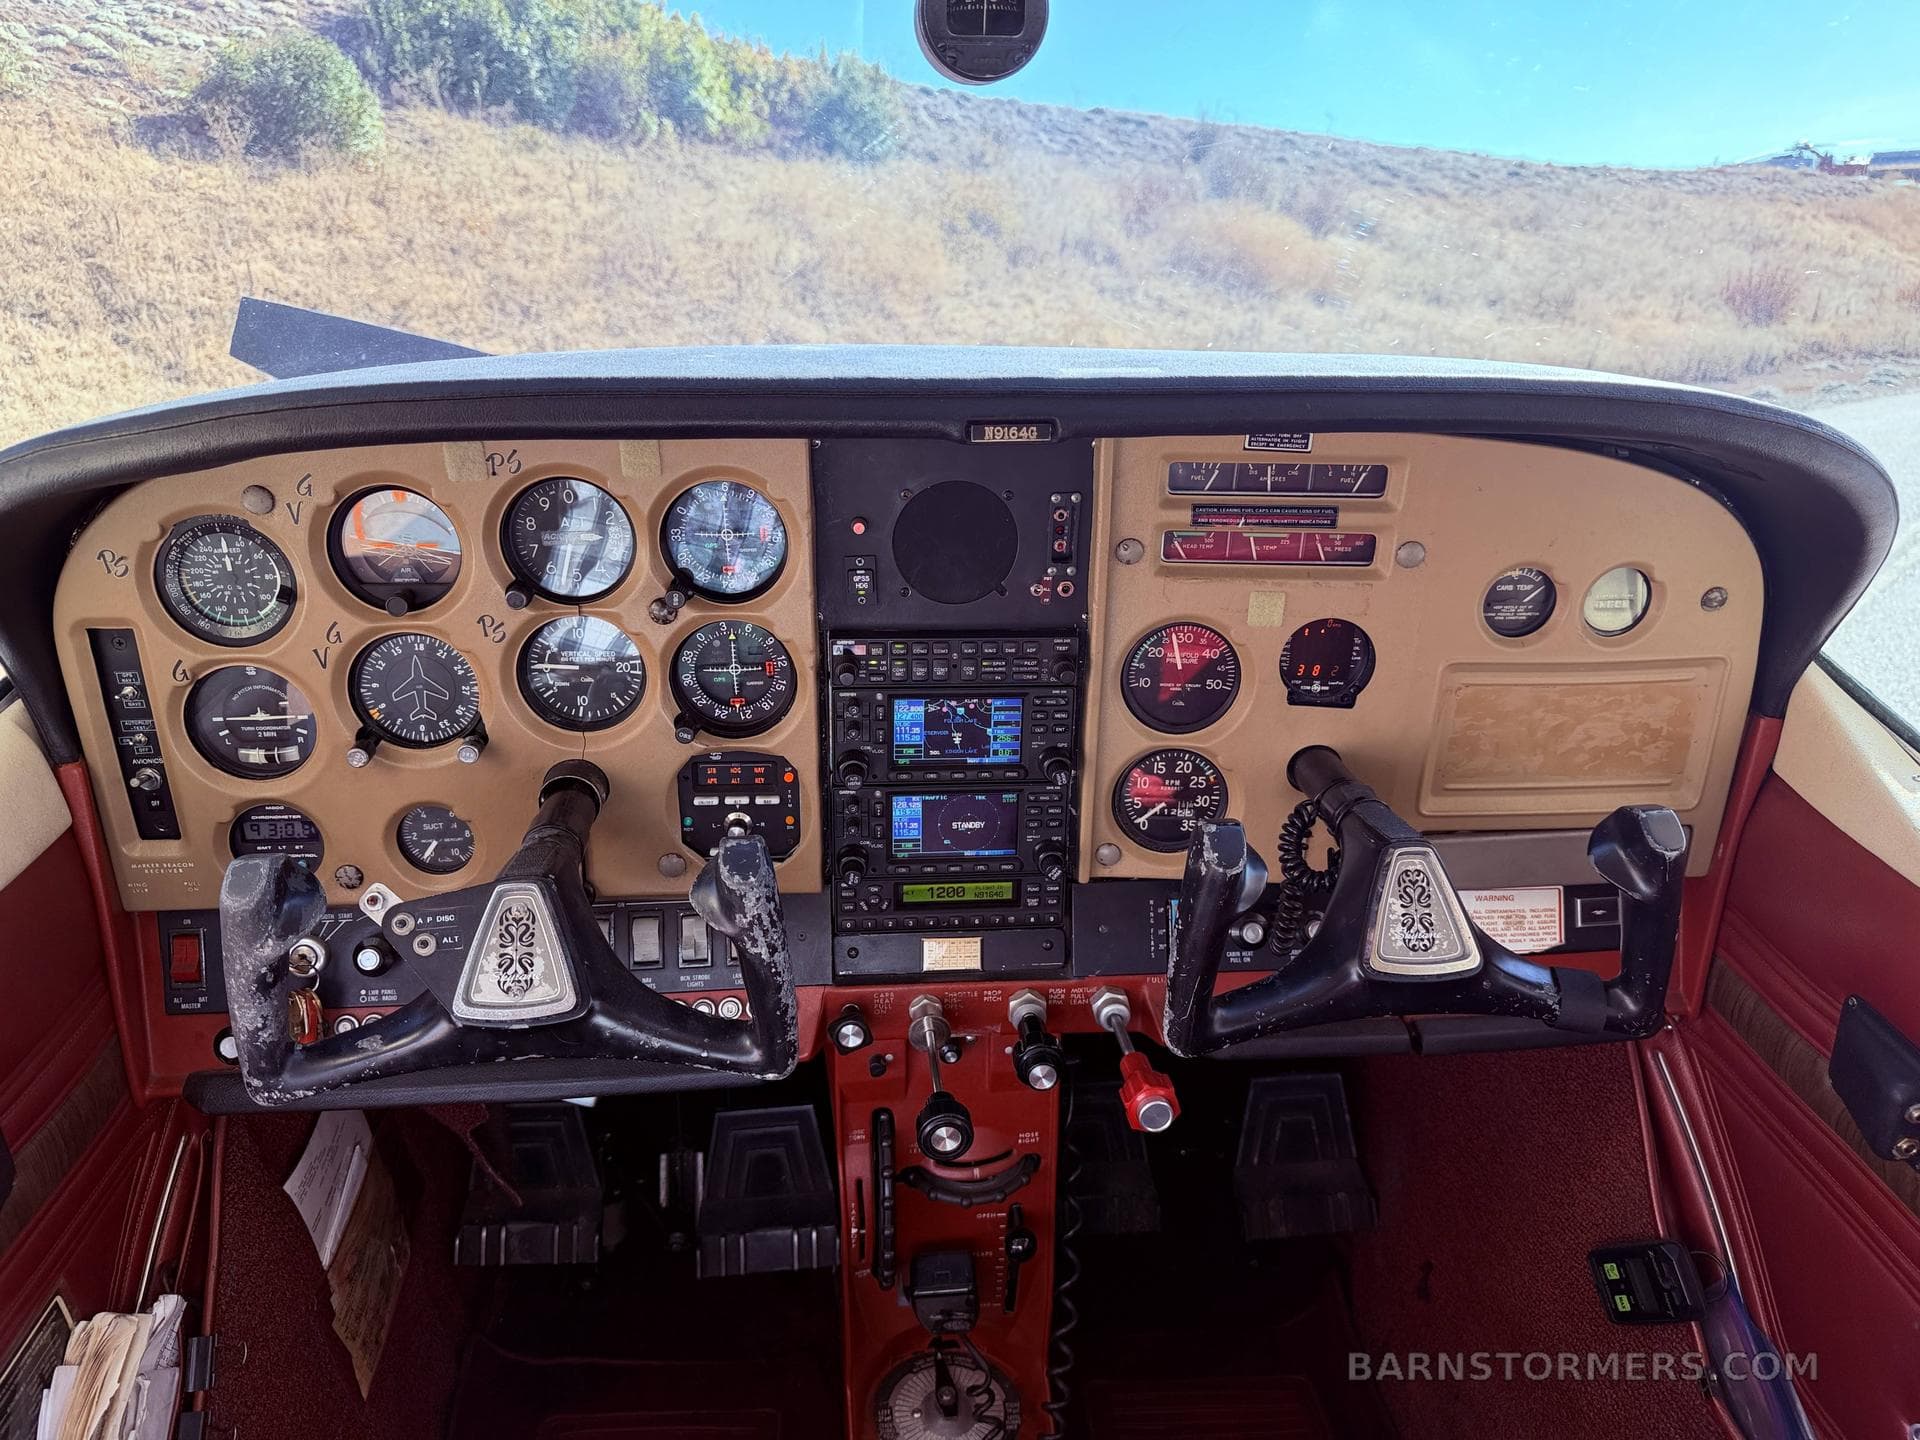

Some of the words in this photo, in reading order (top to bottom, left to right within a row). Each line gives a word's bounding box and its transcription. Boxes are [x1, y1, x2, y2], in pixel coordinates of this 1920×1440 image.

[984, 426, 1037, 440] N9164G
[486, 449, 522, 476] PS
[297, 473, 312, 497] G
[721, 482, 729, 492] 6
[563, 489, 574, 503] 0
[539, 497, 550, 511] 9
[286, 501, 303, 525] V
[605, 511, 615, 525] 2
[526, 517, 536, 531] 8
[529, 544, 539, 558] 7
[97, 549, 129, 577] PS
[546, 561, 556, 575] 6
[595, 560, 607, 574] 4
[572, 570, 582, 582] 5
[476, 614, 507, 643] PS
[720, 622, 727, 631] 3
[745, 624, 752, 632] 6
[327, 621, 342, 644] G
[572, 629, 584, 639] 10
[696, 633, 706, 642] 0
[1177, 633, 1193, 643] 30
[766, 637, 775, 645] 9
[391, 646, 402, 656] 15
[437, 650, 447, 659] 21
[1148, 648, 1164, 658] 20
[1202, 649, 1220, 659] 40
[312, 647, 330, 670] V
[682, 650, 694, 664] 33
[777, 655, 788, 668] 12
[376, 660, 386, 670] 12
[453, 665, 465, 675] 24
[616, 663, 631, 672] 20
[682, 674, 693, 686] 30
[1140, 678, 1151, 688] 10
[1206, 680, 1223, 690] 50
[462, 686, 470, 695] 27
[776, 680, 787, 692] 15
[238, 686, 252, 695] PITCH
[253, 685, 288, 700] INFORMATION
[577, 696, 588, 706] 10
[692, 696, 707, 707] 27
[761, 699, 775, 711] 18
[714, 709, 729, 719] 24
[740, 710, 753, 720] 21
[1154, 762, 1166, 774] 15
[1175, 761, 1192, 773] 20
[1137, 777, 1149, 789] 10
[1190, 777, 1207, 788] 25
[1134, 797, 1142, 808] 5
[1194, 796, 1210, 807] 30
[1140, 820, 1148, 830] 0
[1180, 820, 1197, 832] 35
[451, 848, 460, 856] 10
[927, 886, 966, 899] 1200
[437, 915, 455, 923] DISC
